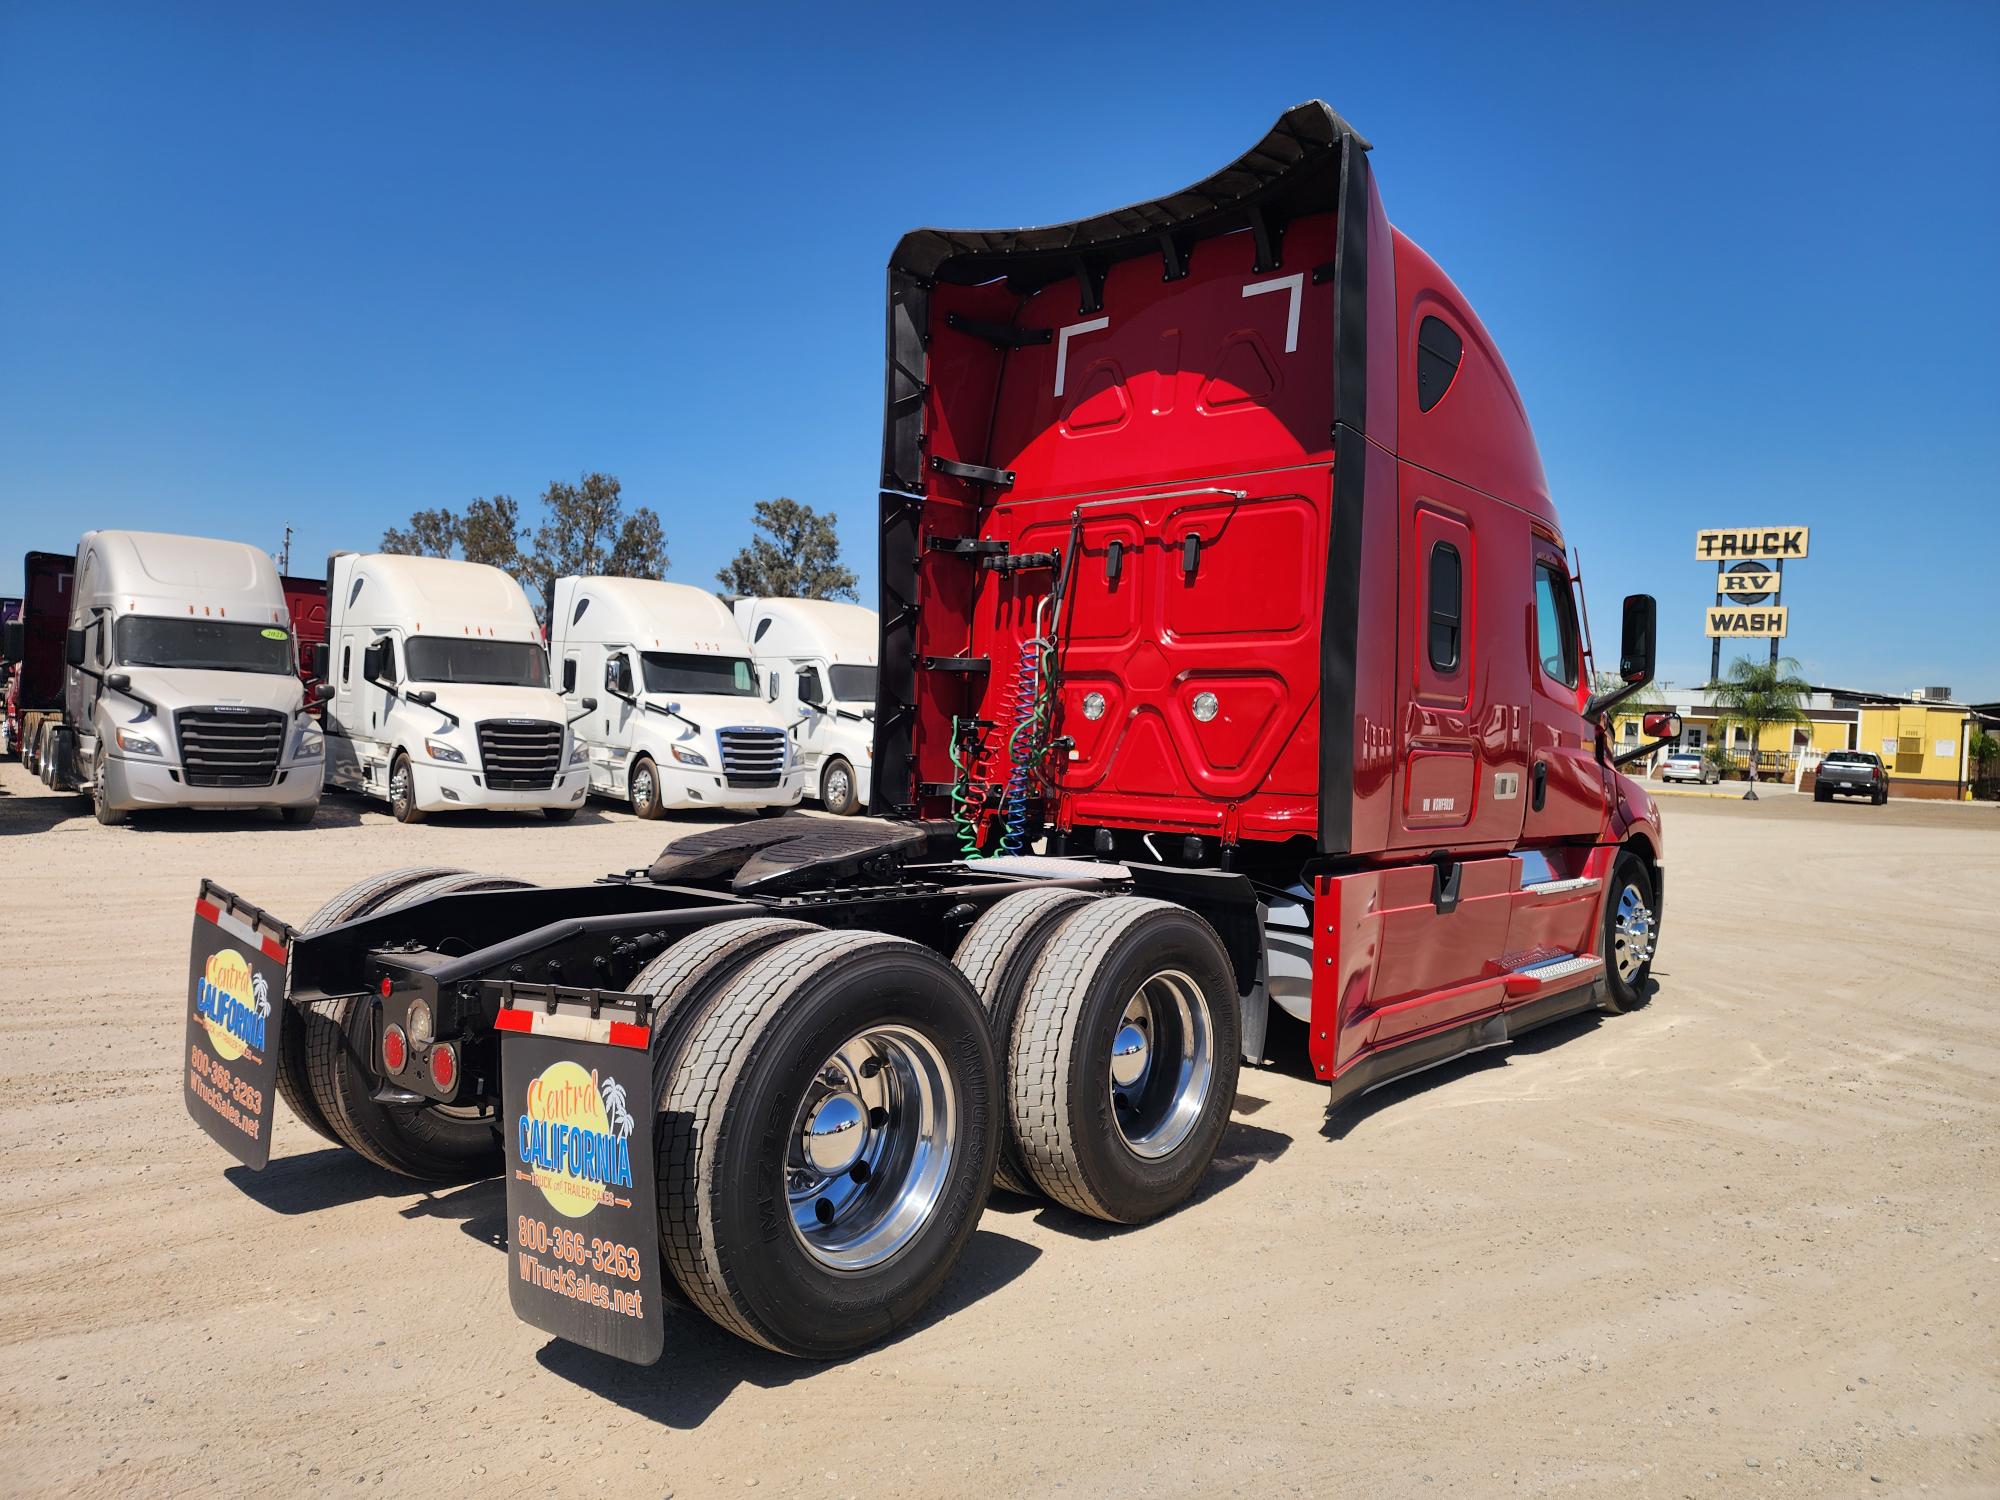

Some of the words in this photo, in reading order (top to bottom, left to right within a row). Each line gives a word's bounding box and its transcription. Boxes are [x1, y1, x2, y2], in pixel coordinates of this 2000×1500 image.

[1701, 532, 1802, 556] TRUCK
[1725, 575, 1773, 590] RV
[1711, 613, 1782, 631] WASH
[206, 954, 252, 994] Central
[197, 976, 265, 1053] CALIFORNIA
[190, 1069, 260, 1140] WTruckSales.net
[191, 1044, 262, 1115] 800-366-3263
[527, 1069, 599, 1122] Central
[519, 1115, 633, 1189] CALIFORNIA
[531, 1172, 552, 1190] TRUCK
[564, 1181, 590, 1199] TRAILER
[592, 1188, 615, 1207] SALES
[518, 1215, 641, 1281] 800-366-3263
[518, 1252, 643, 1319] WTruckSales.net
